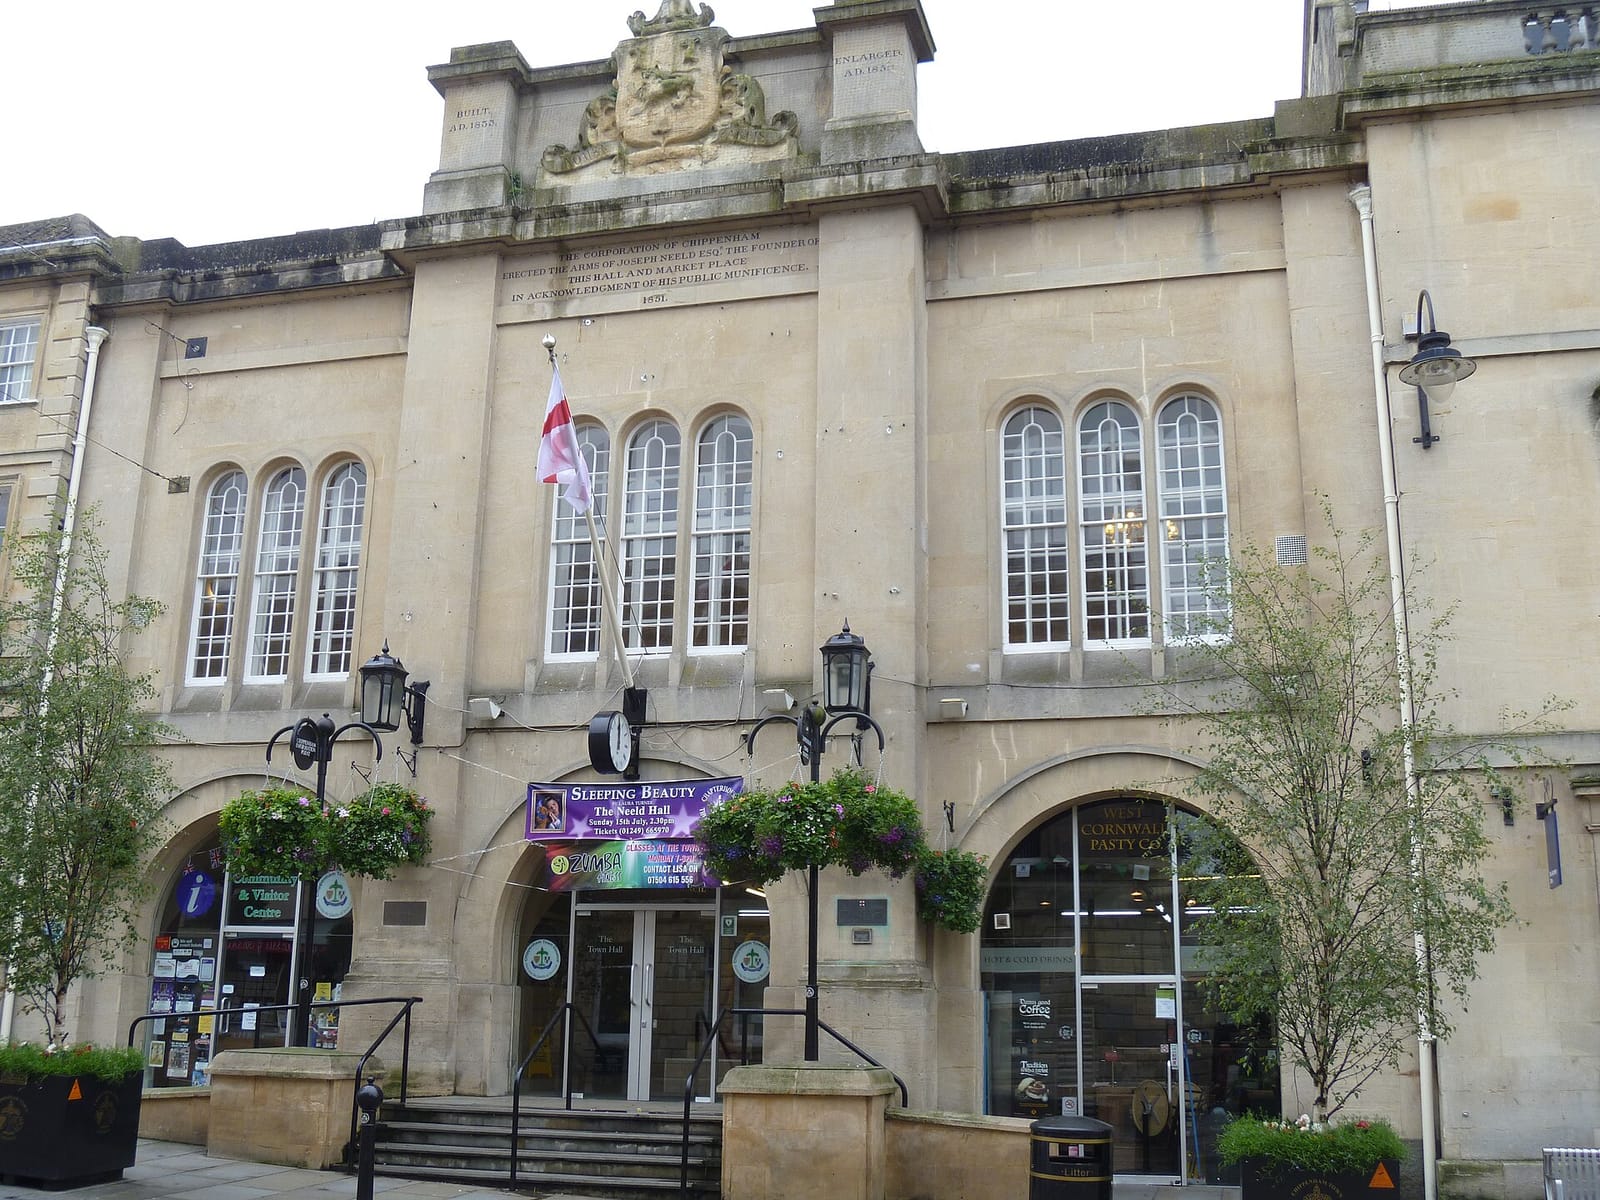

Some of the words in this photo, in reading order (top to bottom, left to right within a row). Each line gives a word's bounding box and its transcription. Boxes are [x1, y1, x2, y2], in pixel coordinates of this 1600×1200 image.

[559, 252, 579, 262] THE
[583, 243, 660, 259] CORPORATION
[663, 241, 678, 250] OF
[682, 232, 760, 248] CHIPPENHAM
[502, 268, 546, 280] ERECTED
[548, 265, 568, 275] THE
[570, 262, 600, 273] ARMS
[602, 260, 615, 268] OF
[617, 255, 657, 267] JOSEPH
[660, 252, 696, 263] NEELD
[726, 245, 748, 255] THE
[751, 238, 806, 252] FOUNDER
[568, 276, 592, 285] THIS
[593, 271, 624, 282] HALL
[625, 269, 652, 278] AND
[656, 262, 705, 275] MARKET
[708, 257, 748, 269] PLACE
[511, 293, 524, 302] IN
[526, 281, 641, 300] ACKNOWLEDGMENT
[642, 279, 657, 288] OF
[658, 277, 677, 287] HIS
[679, 272, 722, 284] PUBLIC
[594, 806, 614, 816] The
[616, 805, 645, 816] Neeld
[648, 805, 671, 815] Hall
[1104, 807, 1143, 818] WEST
[589, 819, 614, 827] Sunday
[649, 817, 675, 826] 2.30pm
[619, 827, 644, 836] (01249)
[1090, 839, 1136, 851] PASTY
[569, 852, 622, 874] ZUMBA
[643, 865, 671, 873] CONTACT
[672, 865, 687, 873] LISA
[668, 876, 679, 884] 615
[238, 889, 250, 901] &
[252, 888, 290, 901] Visitor
[243, 905, 281, 918] Centre
[599, 935, 613, 943] The
[679, 935, 693, 943] The
[587, 945, 607, 953] Town
[608, 945, 623, 953] Hall
[1019, 1004, 1051, 1014] Coffee
